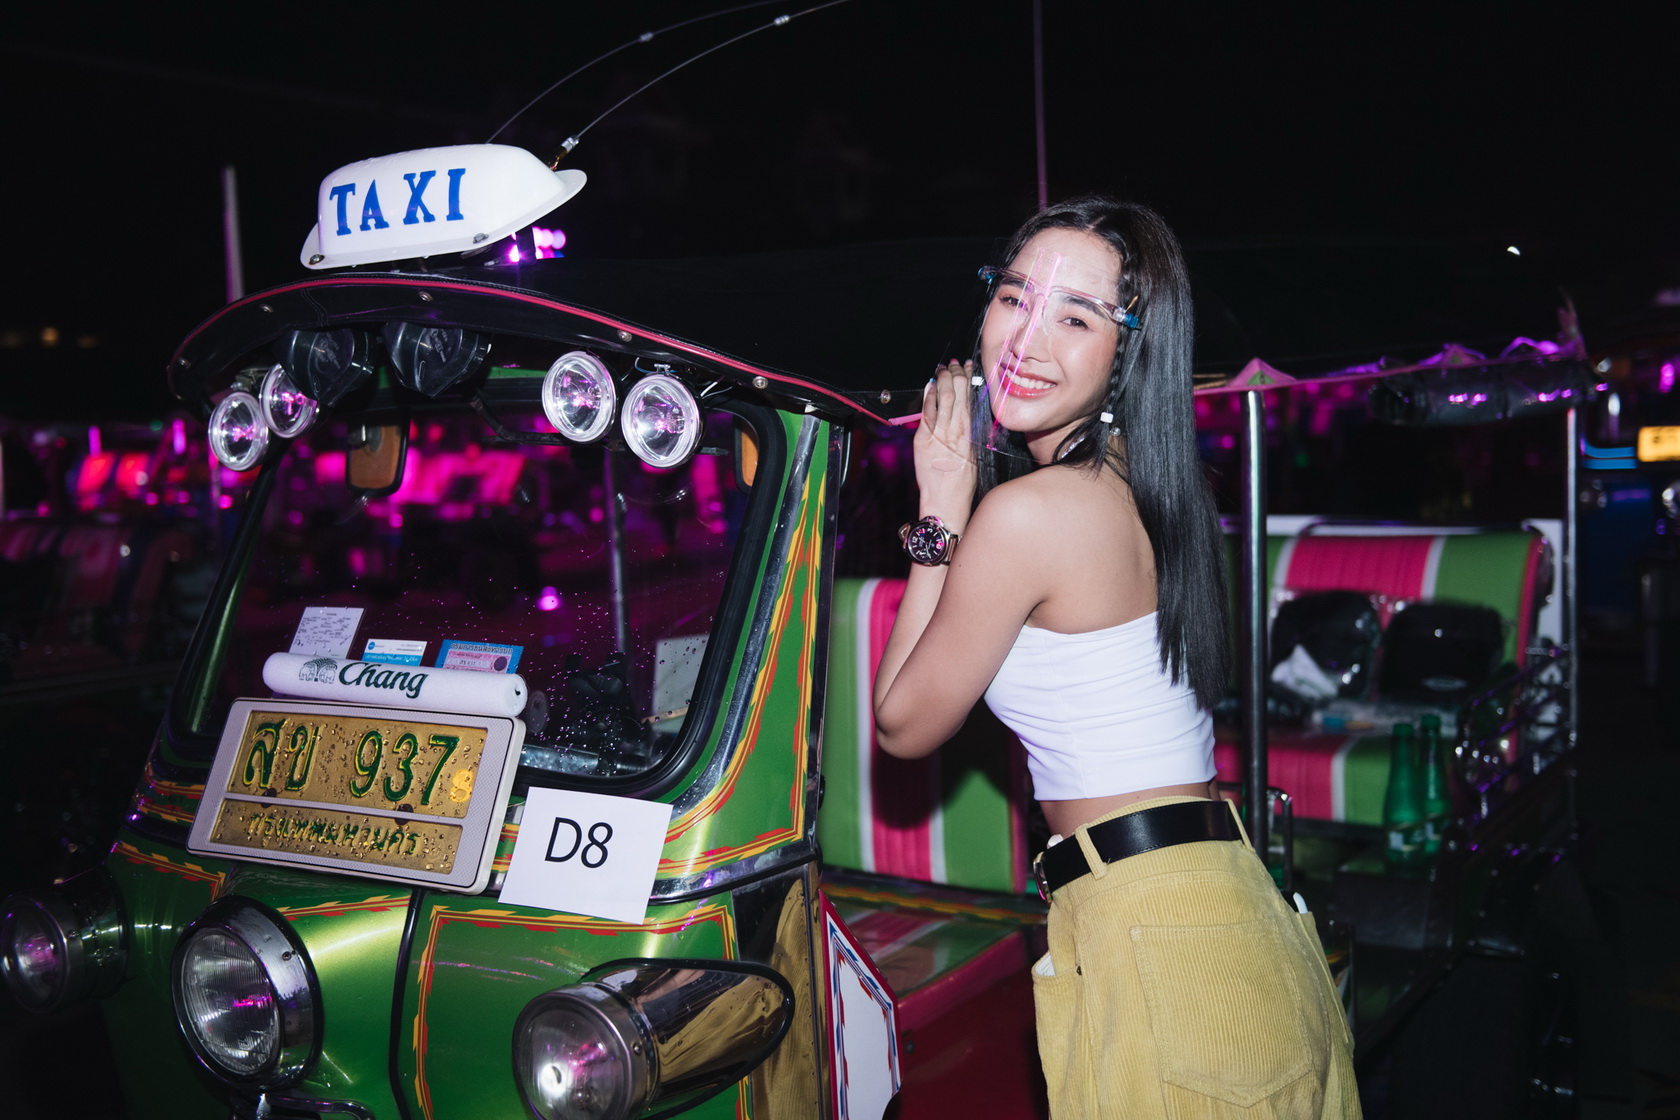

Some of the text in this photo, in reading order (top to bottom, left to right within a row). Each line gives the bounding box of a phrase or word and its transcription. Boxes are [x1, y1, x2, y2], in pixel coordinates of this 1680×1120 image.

[329, 168, 466, 236] TAXI
[338, 662, 429, 699] Chang
[243, 718, 460, 805] สข 937
[544, 816, 613, 869] D8
